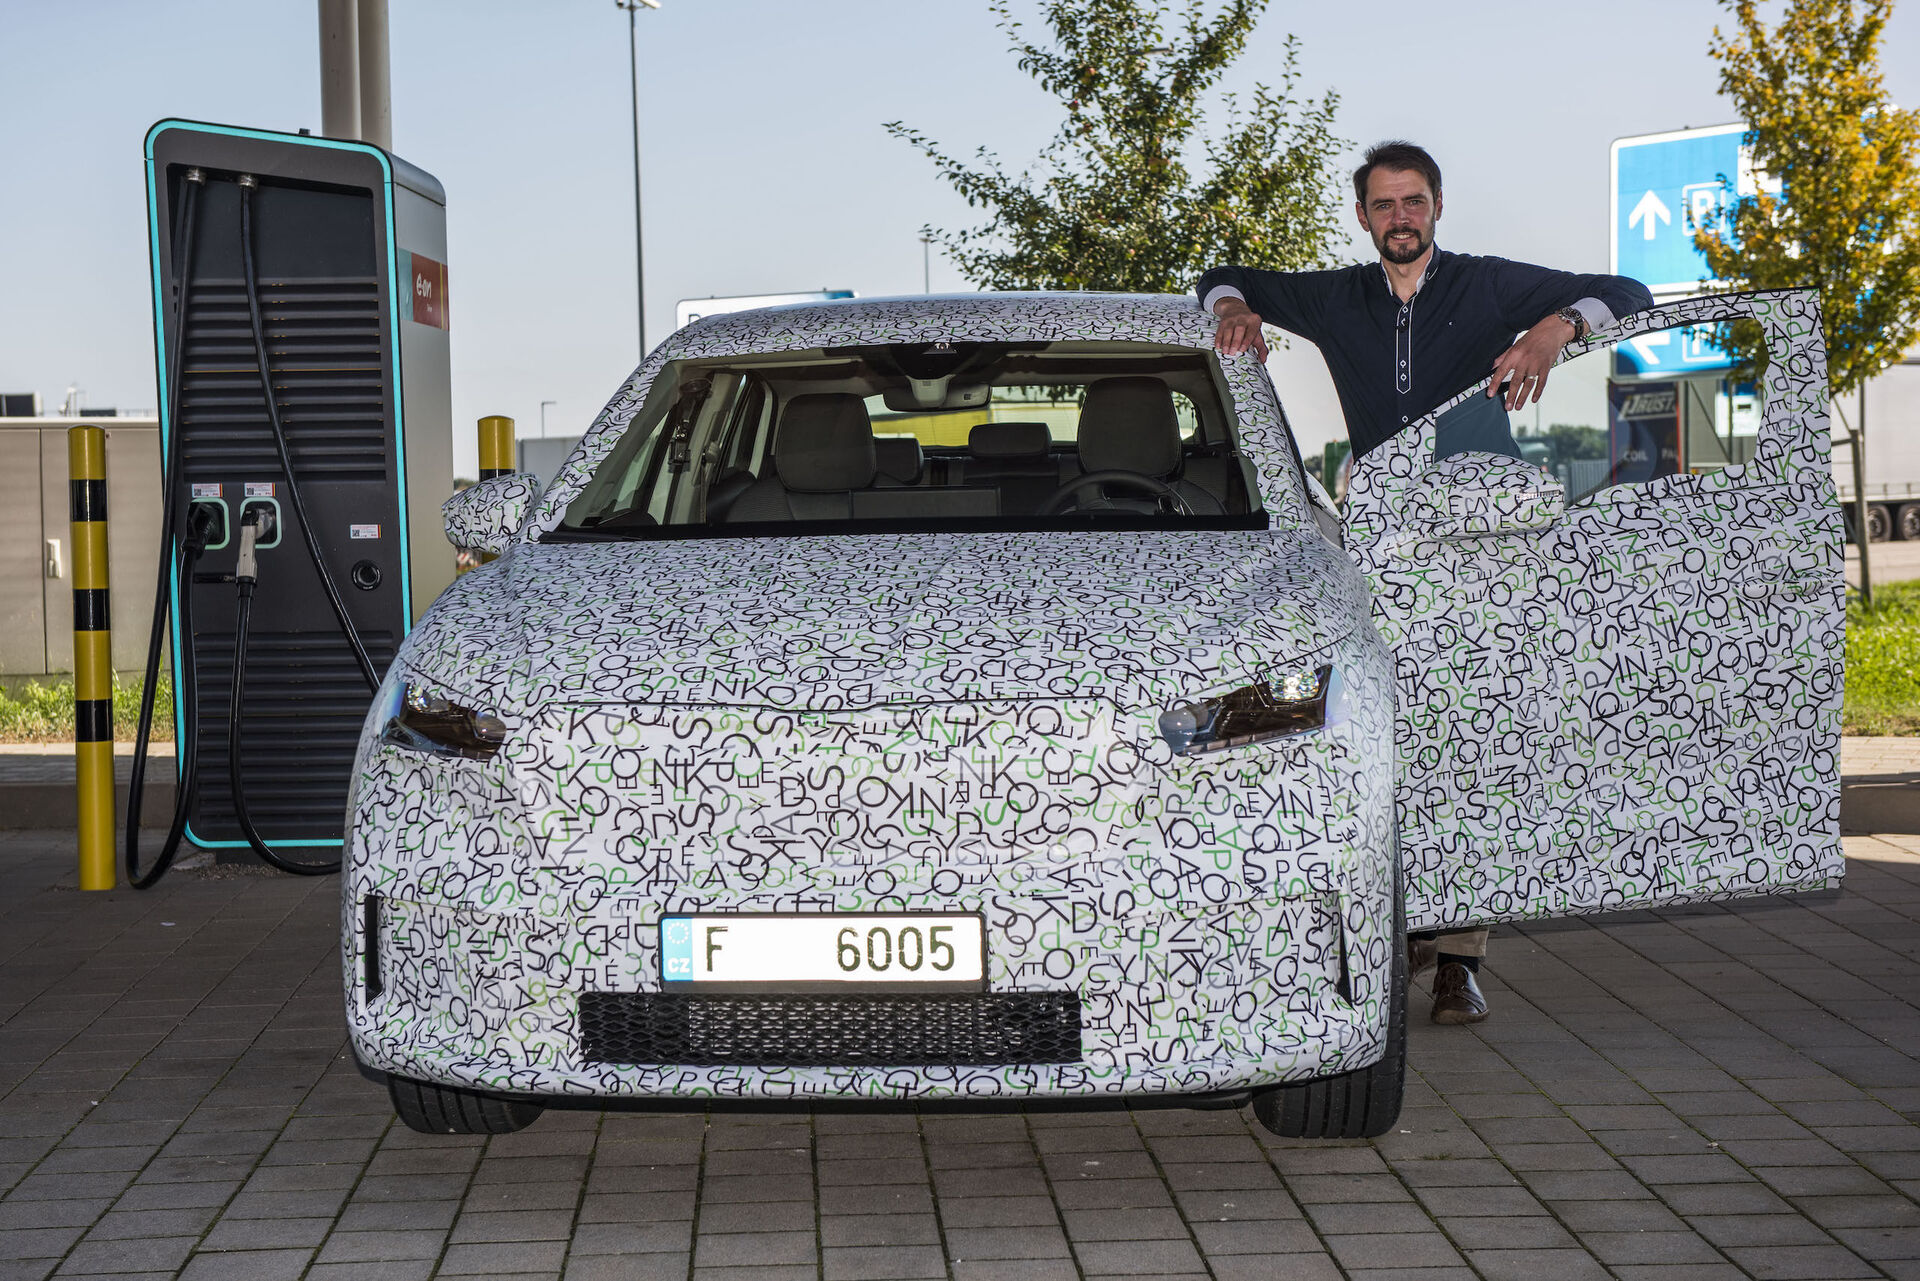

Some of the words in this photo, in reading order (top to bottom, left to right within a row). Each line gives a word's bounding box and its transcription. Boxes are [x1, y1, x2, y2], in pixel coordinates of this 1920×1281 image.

[1692, 190, 1715, 229] P
[668, 957, 691, 973] CZ
[705, 925, 729, 972] F
[836, 925, 955, 972] 6005
